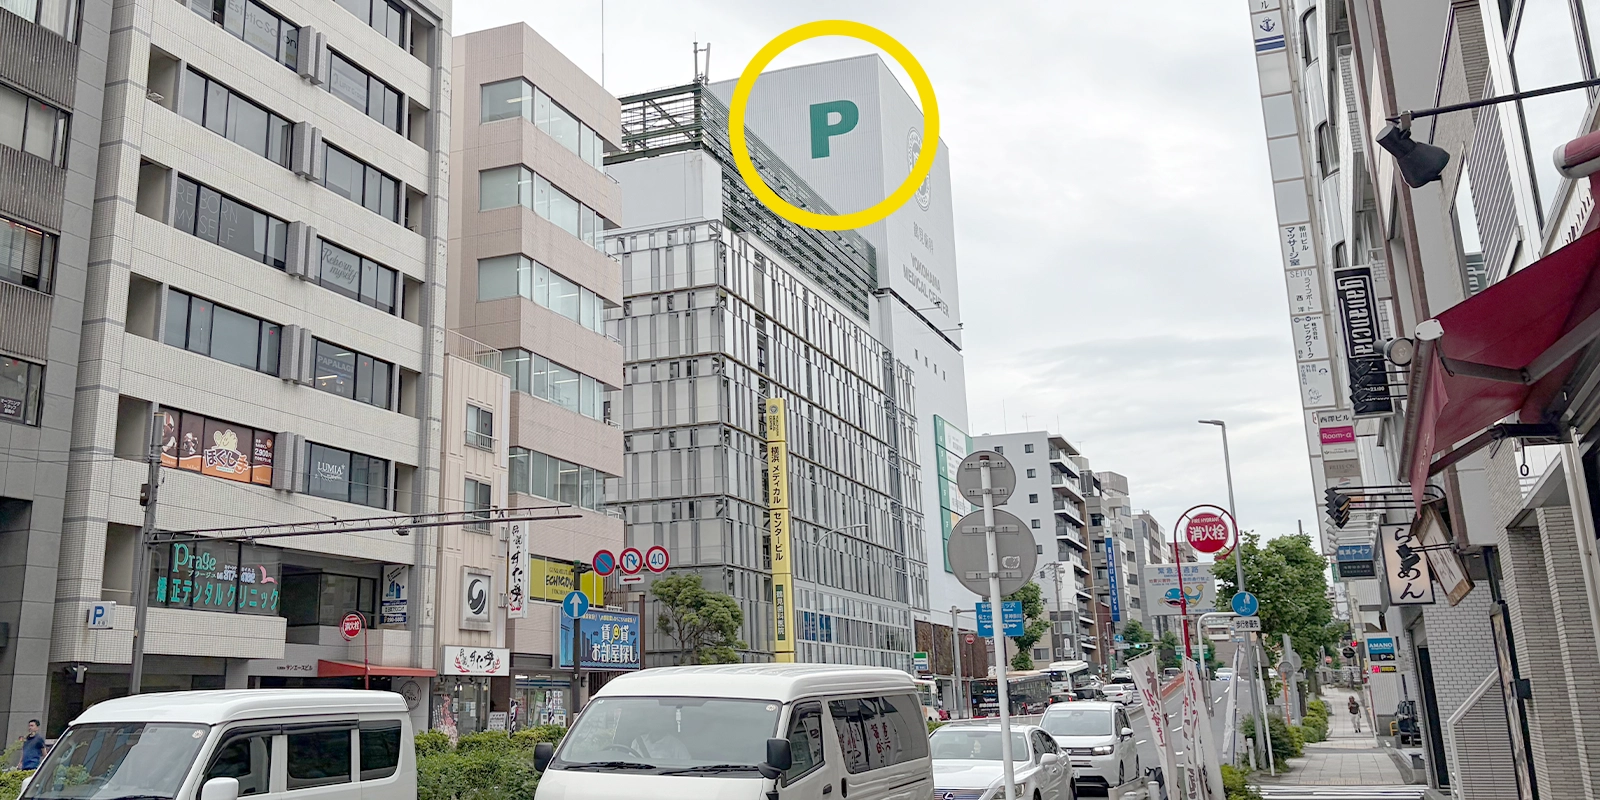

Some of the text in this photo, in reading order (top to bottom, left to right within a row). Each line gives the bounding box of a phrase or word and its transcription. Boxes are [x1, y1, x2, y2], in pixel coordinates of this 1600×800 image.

[810, 100, 859, 159] P
[910, 252, 942, 295] YOKOHAMA
[1290, 269, 1313, 278] SEIYO
[903, 264, 950, 319] MEDICAL CENTER
[317, 461, 343, 475] LUMIA
[771, 446, 784, 561] 横浜 メディカル センタービル
[1189, 523, 1227, 542] 消火栓
[172, 543, 217, 573] Prage
[651, 552, 664, 565] 40
[156, 576, 279, 611] 矯正デンタルクリニック
[92, 605, 105, 625] P
[591, 642, 638, 664] お部屋探し
